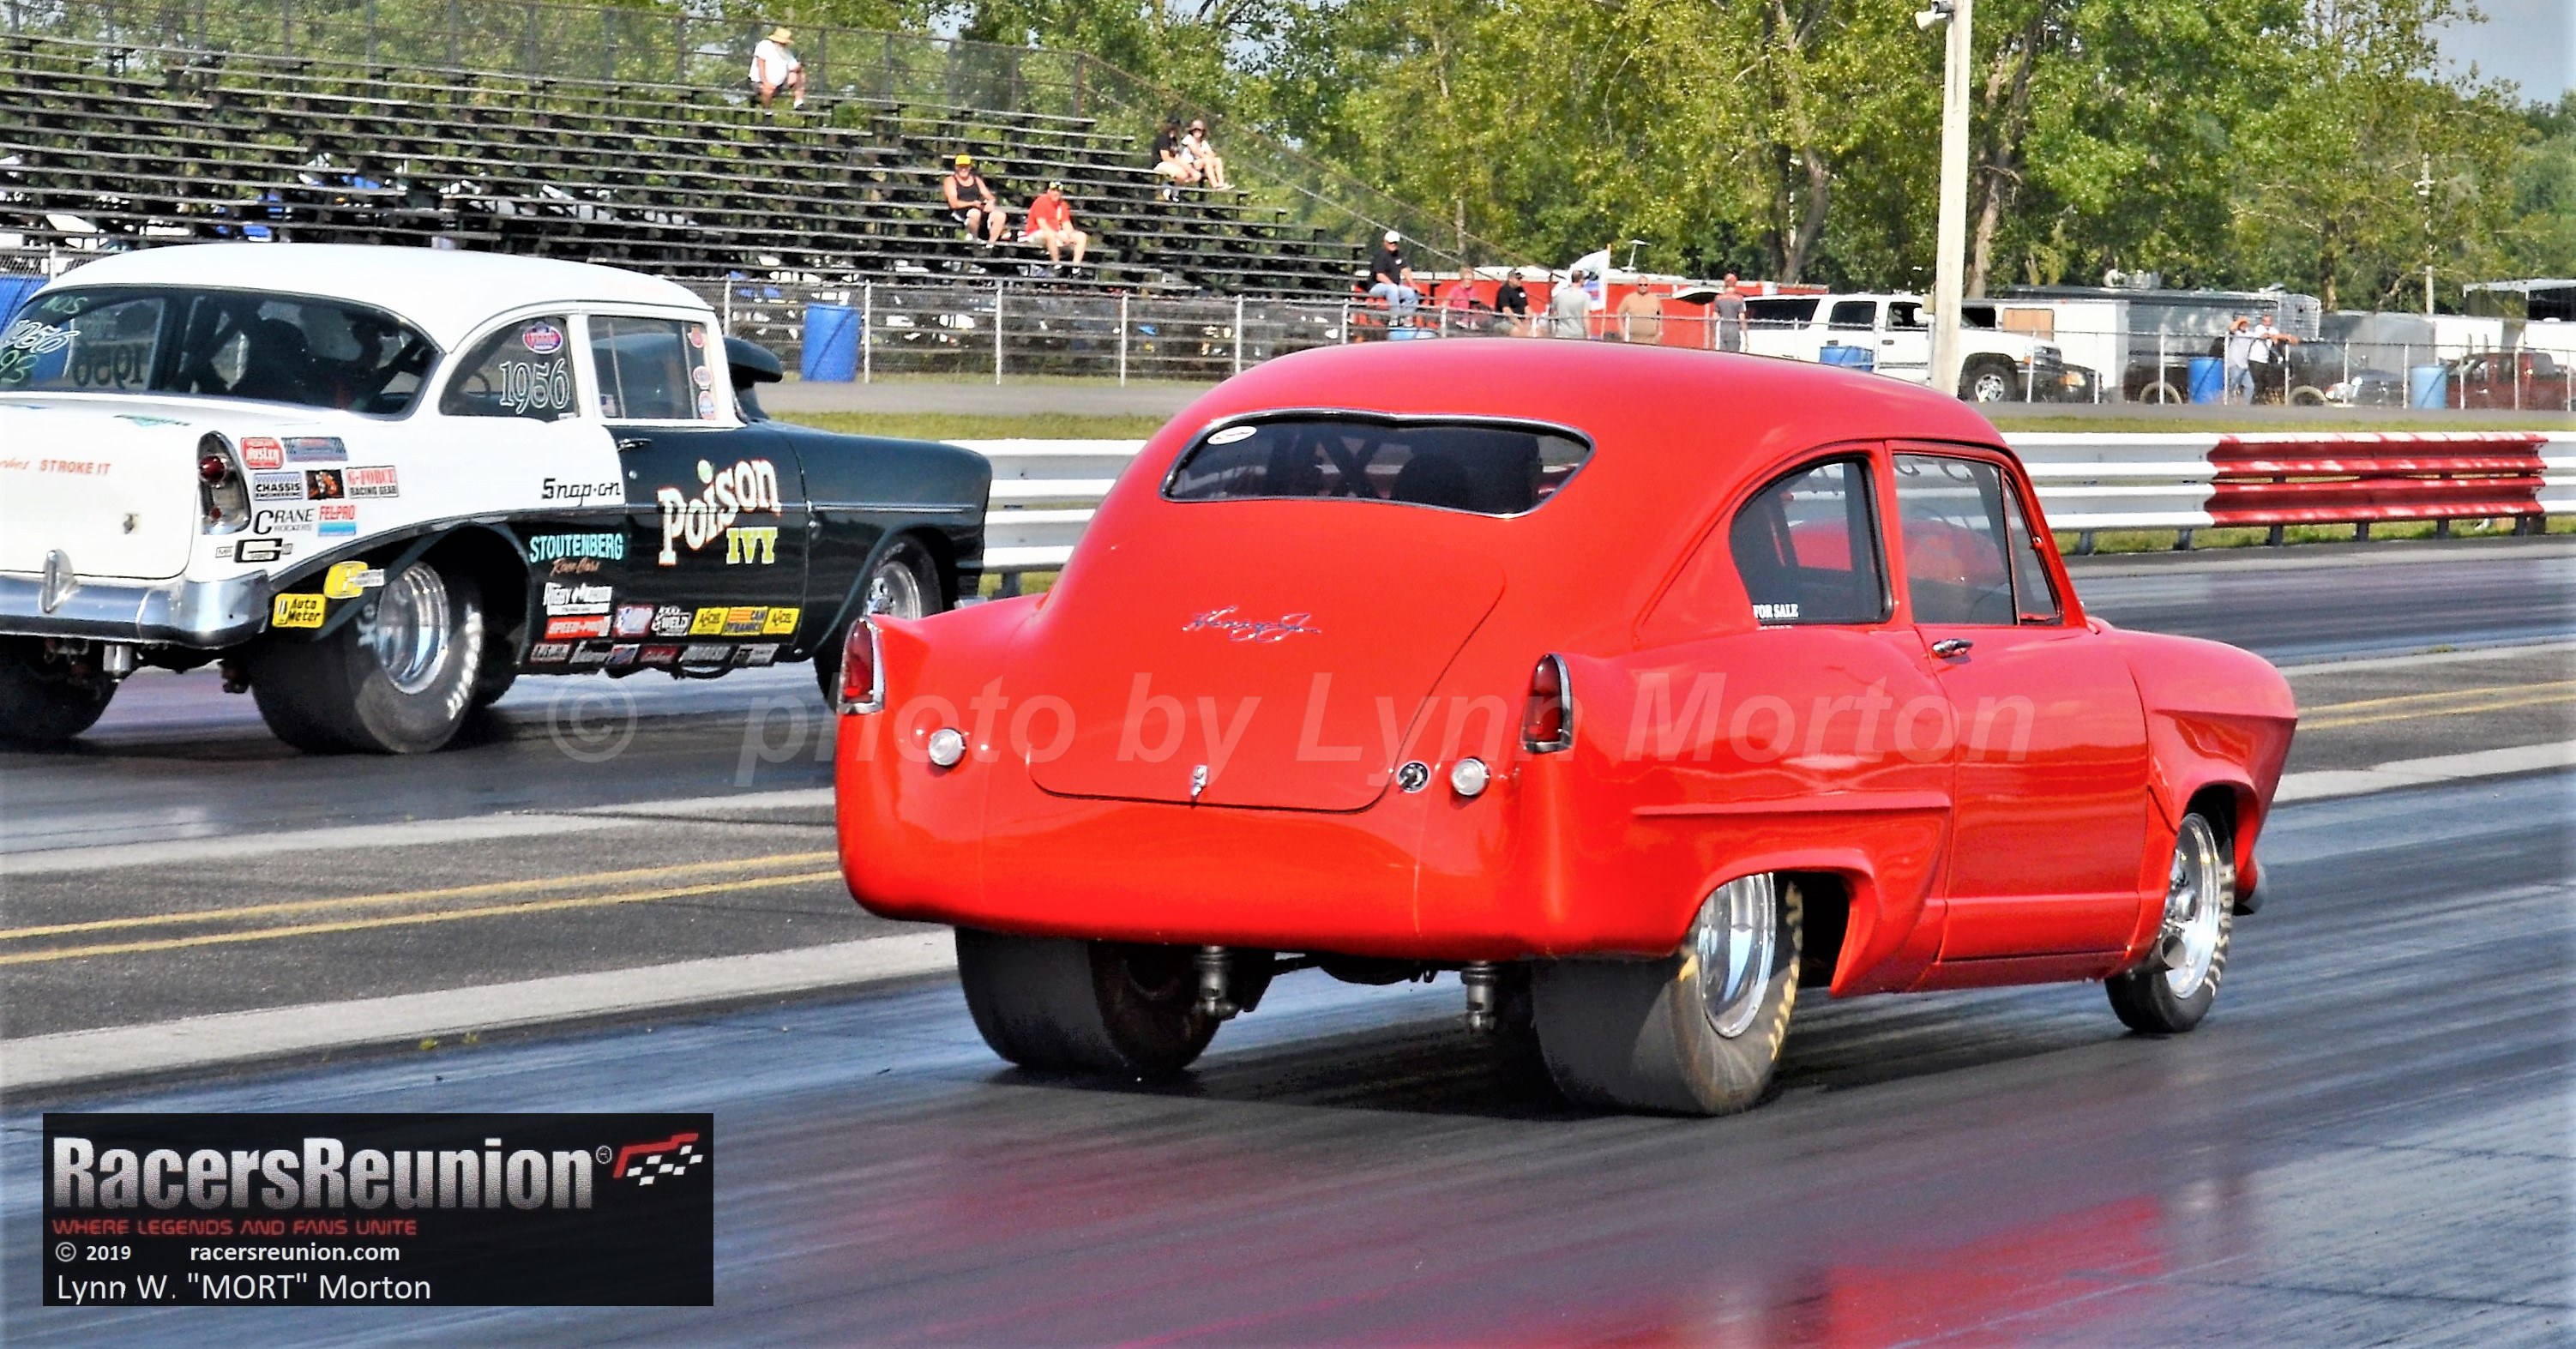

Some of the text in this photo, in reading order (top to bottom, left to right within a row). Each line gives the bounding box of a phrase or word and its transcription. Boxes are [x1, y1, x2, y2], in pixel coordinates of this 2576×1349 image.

[499, 358, 570, 414] 1956
[40, 459, 94, 474] STROKE
[97, 463, 112, 475] IT
[256, 483, 300, 492] CHASSIS
[350, 486, 377, 497] RACING
[657, 458, 783, 568] Poison
[253, 508, 315, 535] CRANE
[529, 533, 624, 563] STOUTENBERG
[725, 526, 779, 565] IVY
[290, 599, 317, 610] Auto
[1752, 603, 1799, 618] FOR SALE
[287, 611, 322, 622] Meter
